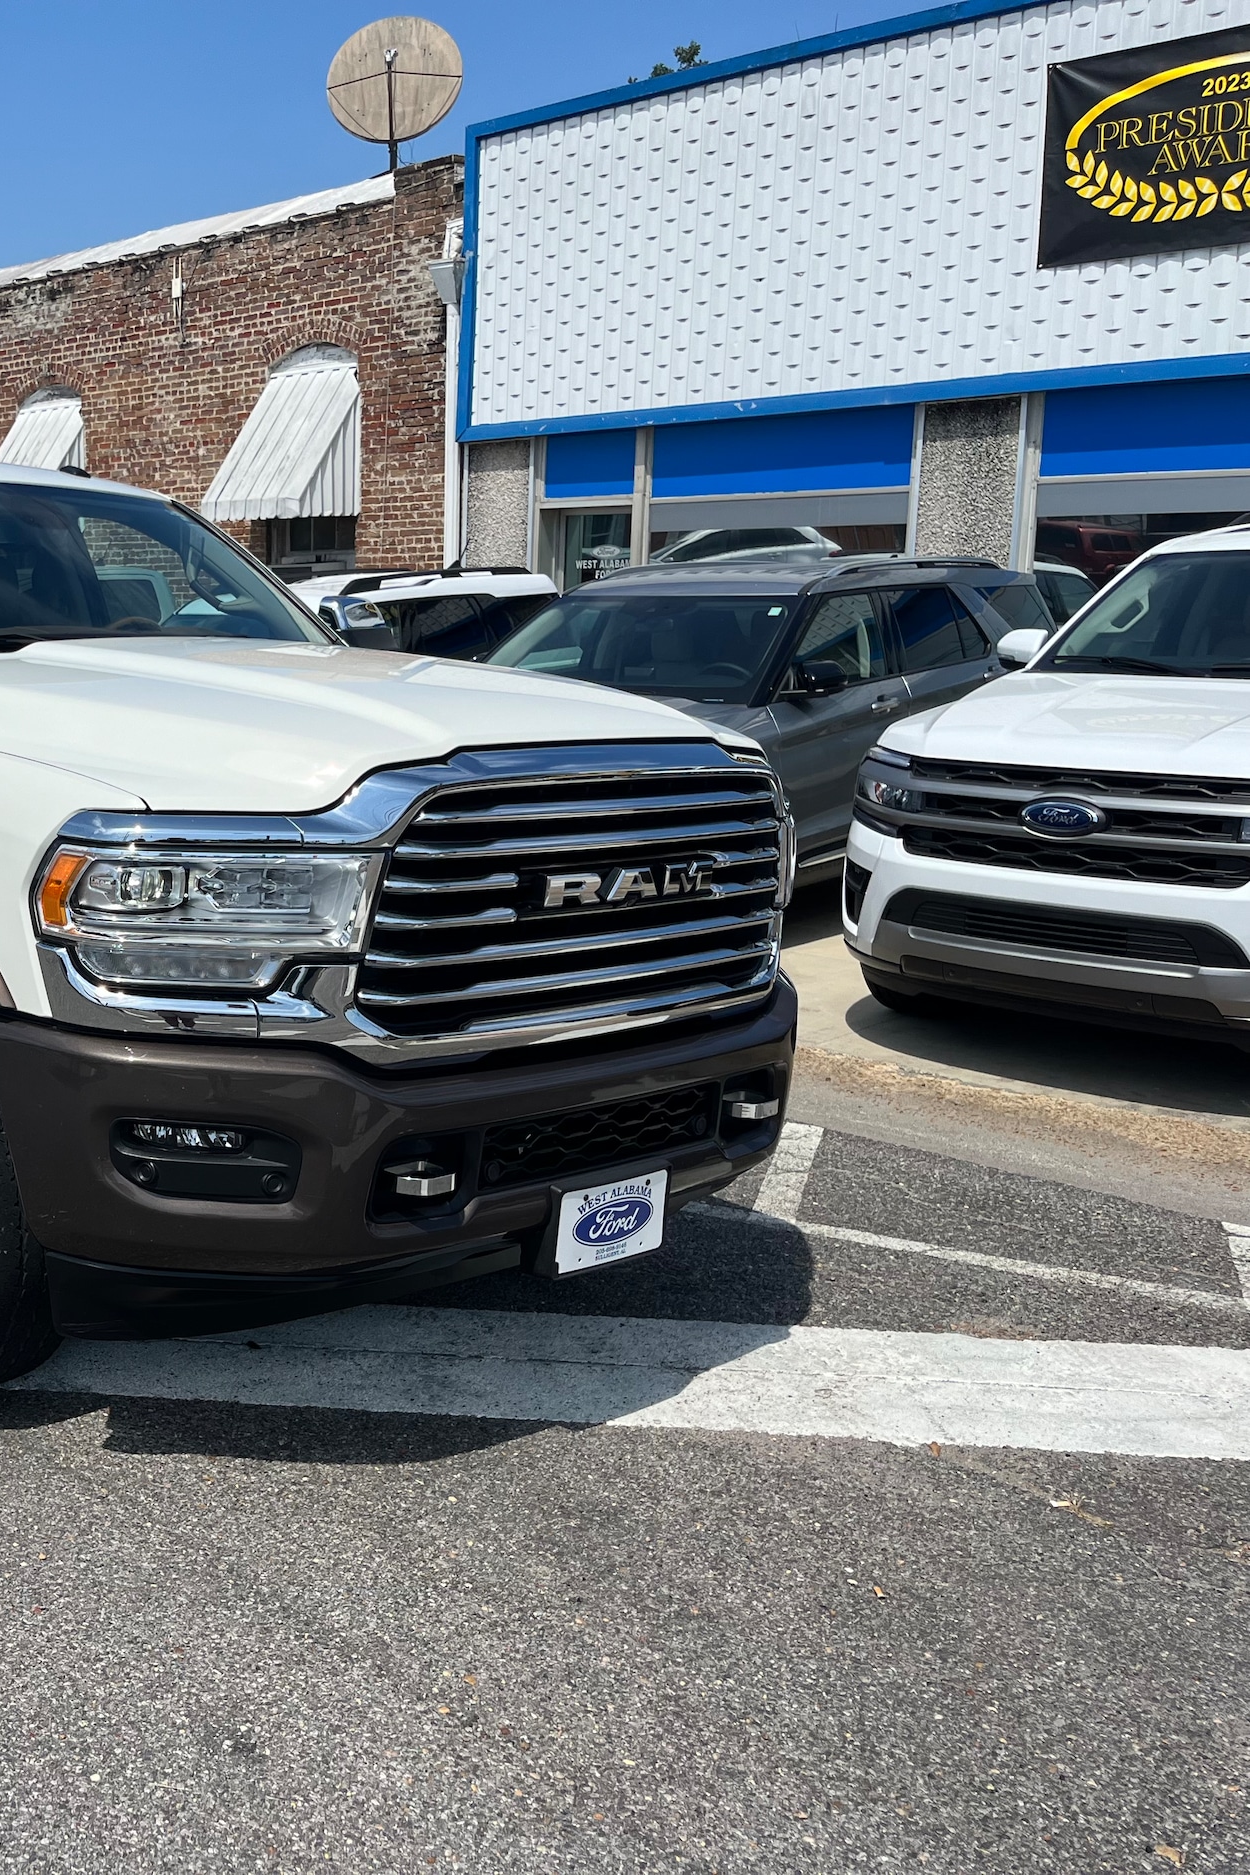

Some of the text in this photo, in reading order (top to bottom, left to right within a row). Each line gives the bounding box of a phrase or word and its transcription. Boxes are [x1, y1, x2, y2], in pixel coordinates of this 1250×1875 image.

[1201, 71, 1250, 97] 2023
[575, 558, 631, 569] WEST ALABAM
[1037, 807, 1080, 825] Ford
[542, 860, 714, 908] RAM
[577, 1185, 652, 1215] WEST ALABAMA
[588, 1204, 640, 1239] Ford
